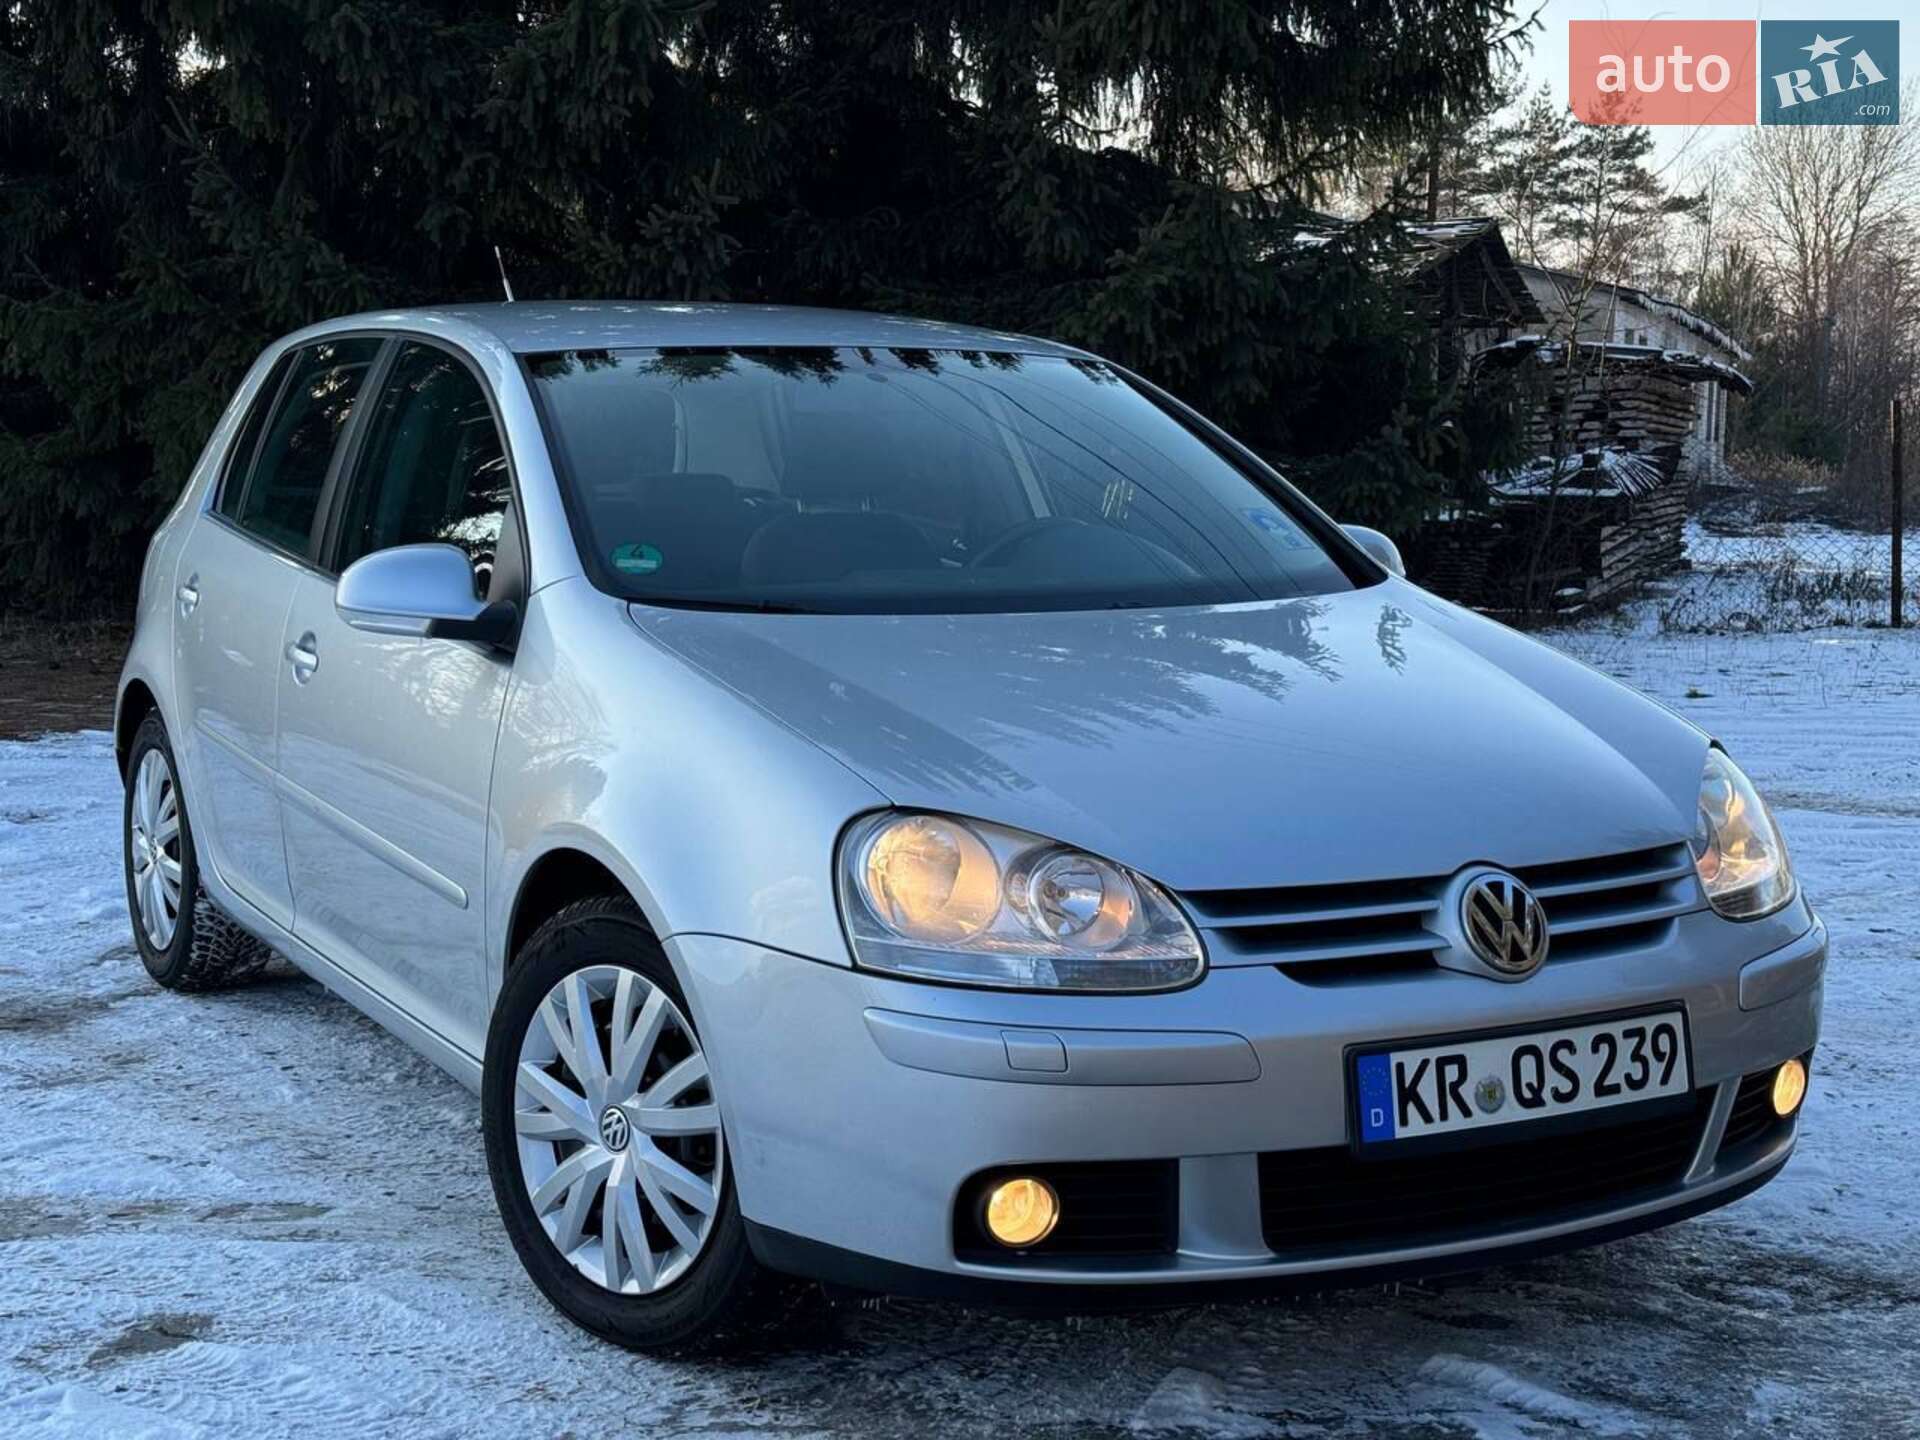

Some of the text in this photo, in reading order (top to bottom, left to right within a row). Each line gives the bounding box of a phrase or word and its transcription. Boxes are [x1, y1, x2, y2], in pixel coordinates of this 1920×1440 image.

[1395, 1023, 1679, 1127] KR QS 239
[1371, 1108, 1384, 1128] D
